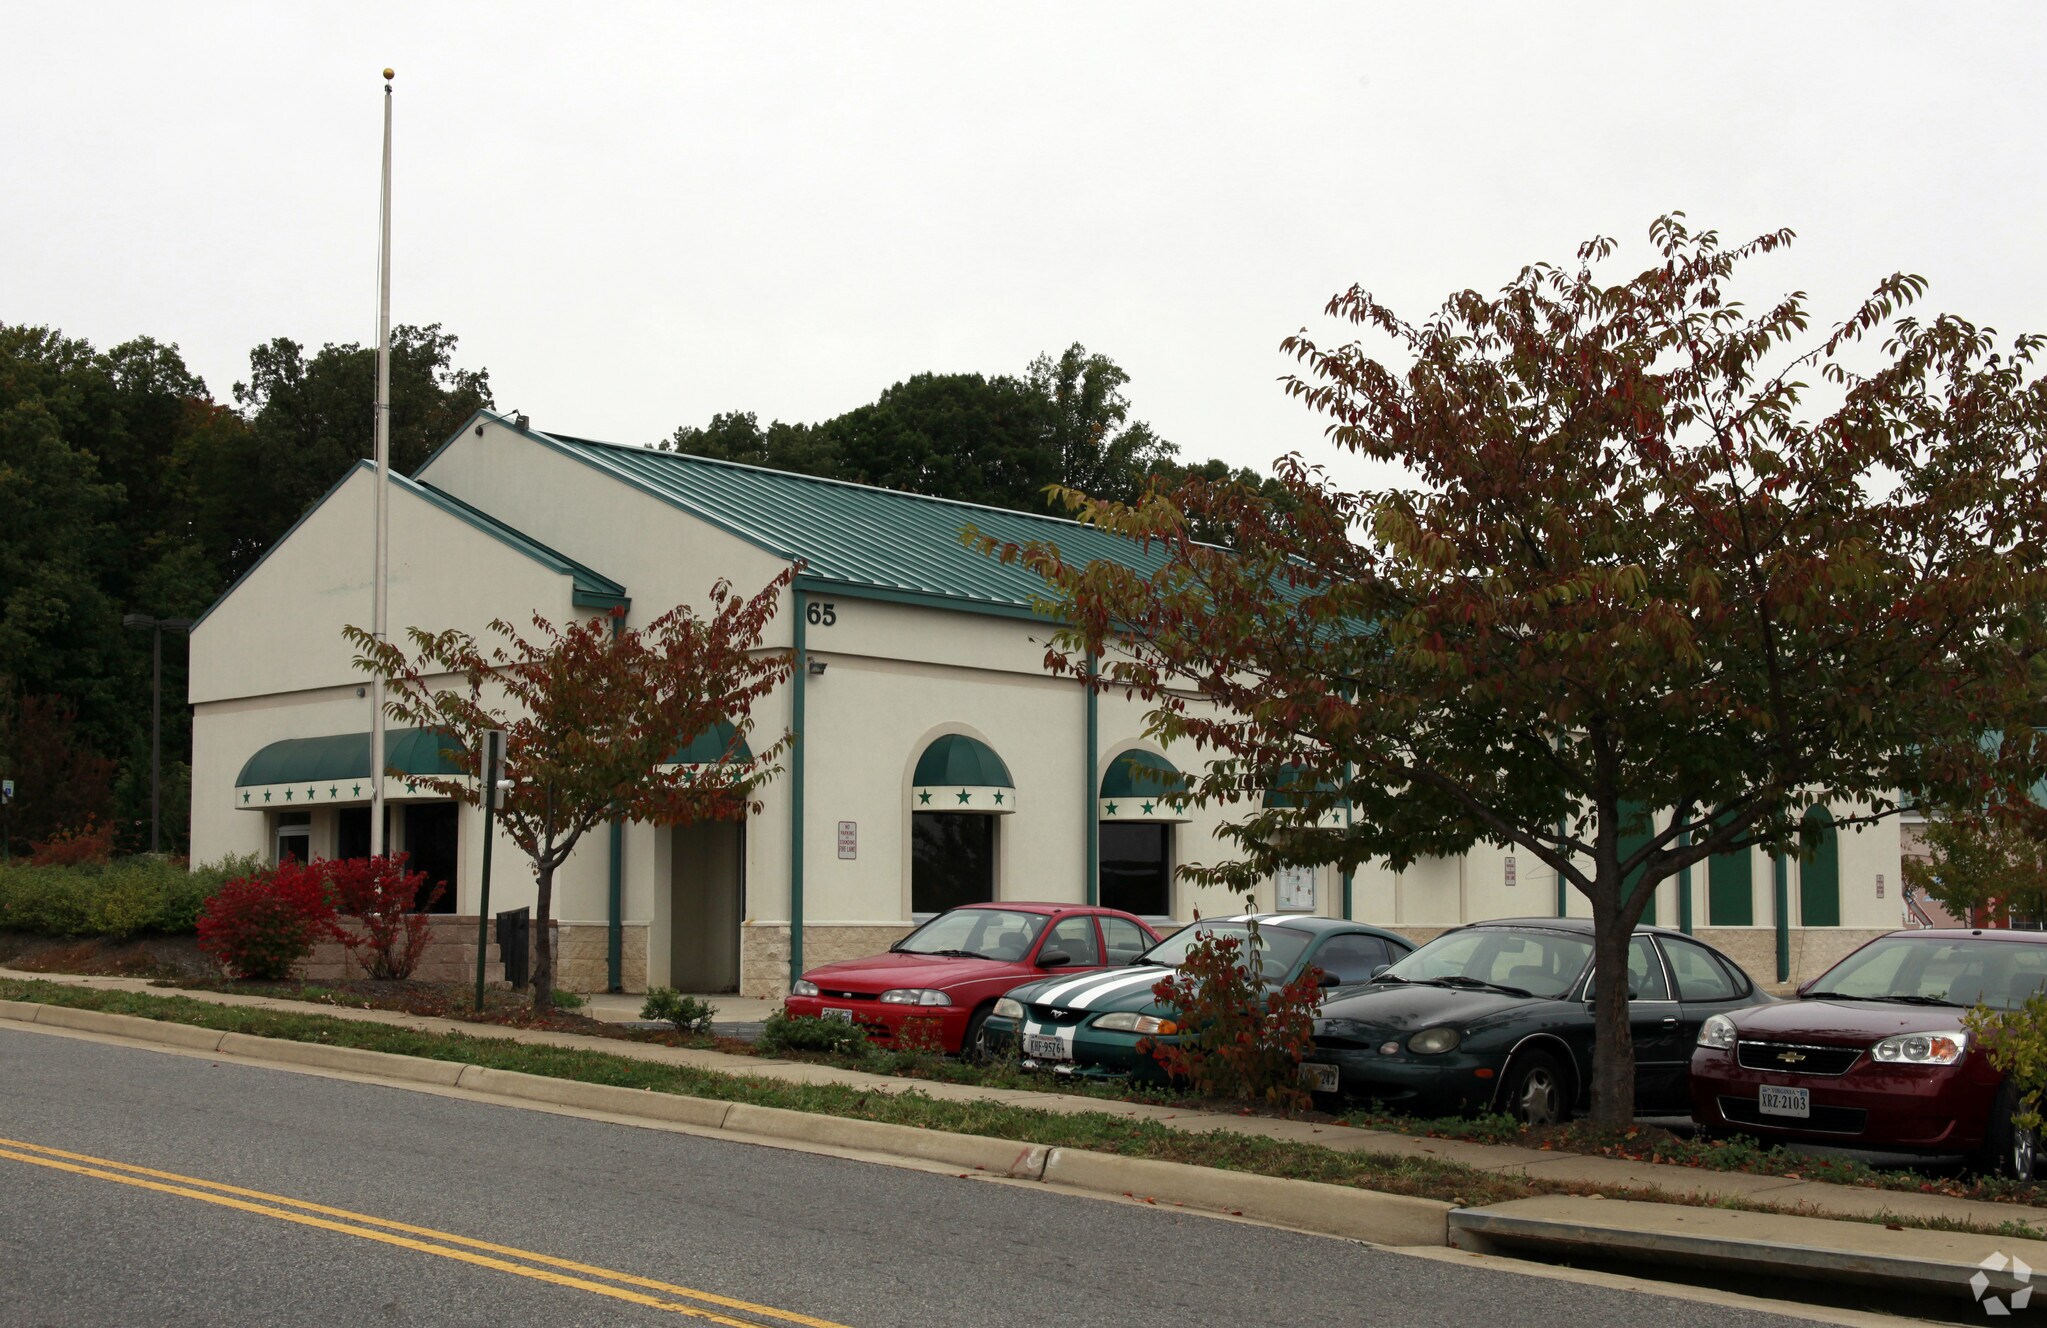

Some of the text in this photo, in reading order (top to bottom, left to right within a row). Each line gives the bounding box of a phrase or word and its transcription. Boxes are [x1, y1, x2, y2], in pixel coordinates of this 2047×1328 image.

[807, 602, 836, 626] 65
[1771, 1087, 1796, 1095] VIRGINIA
[1762, 1093, 1806, 1110] XRZ-2103
